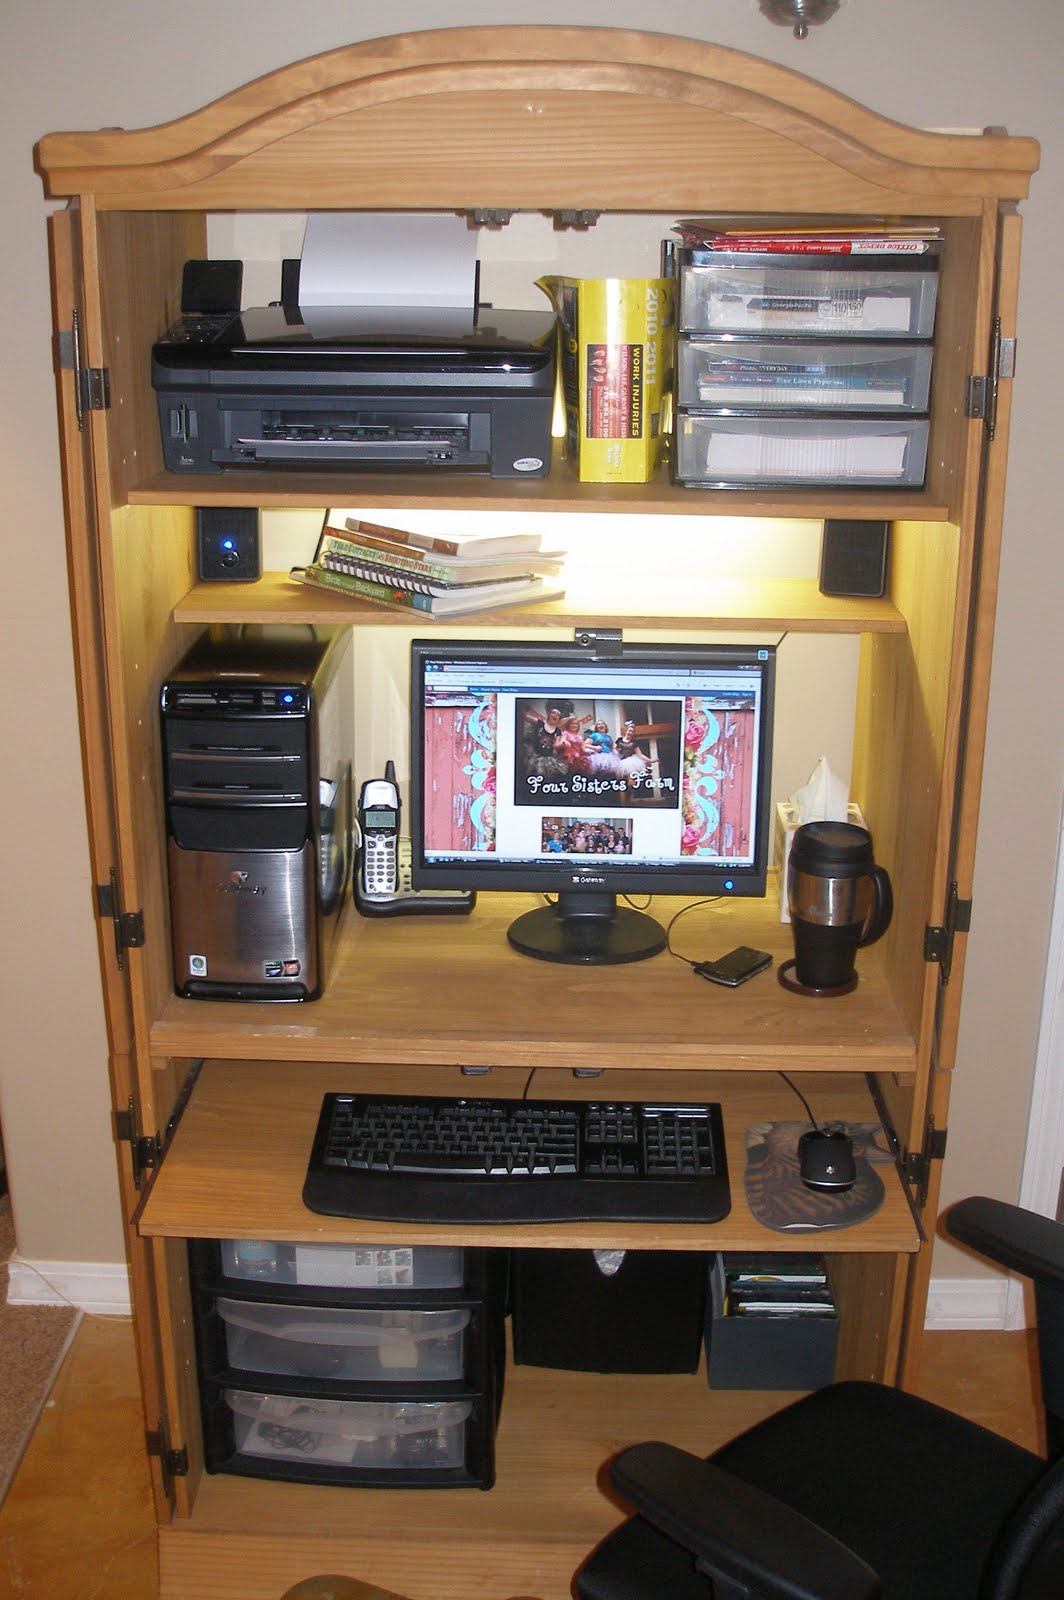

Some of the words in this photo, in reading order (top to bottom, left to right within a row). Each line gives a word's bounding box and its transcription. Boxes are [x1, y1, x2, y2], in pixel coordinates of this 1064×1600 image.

[887, 243, 918, 252] Office
[645, 287, 659, 335] 2010
[631, 347, 640, 380] WORK
[645, 341, 657, 384] 2011
[631, 384, 640, 436] INJURIES
[620, 423, 628, 438] HESS
[414, 560, 433, 573] STARS
[325, 573, 342, 585] Birds
[355, 581, 385, 597] Backyard
[527, 775, 569, 794] Four
[571, 774, 627, 794] Sisters
[629, 770, 675, 791] Farm
